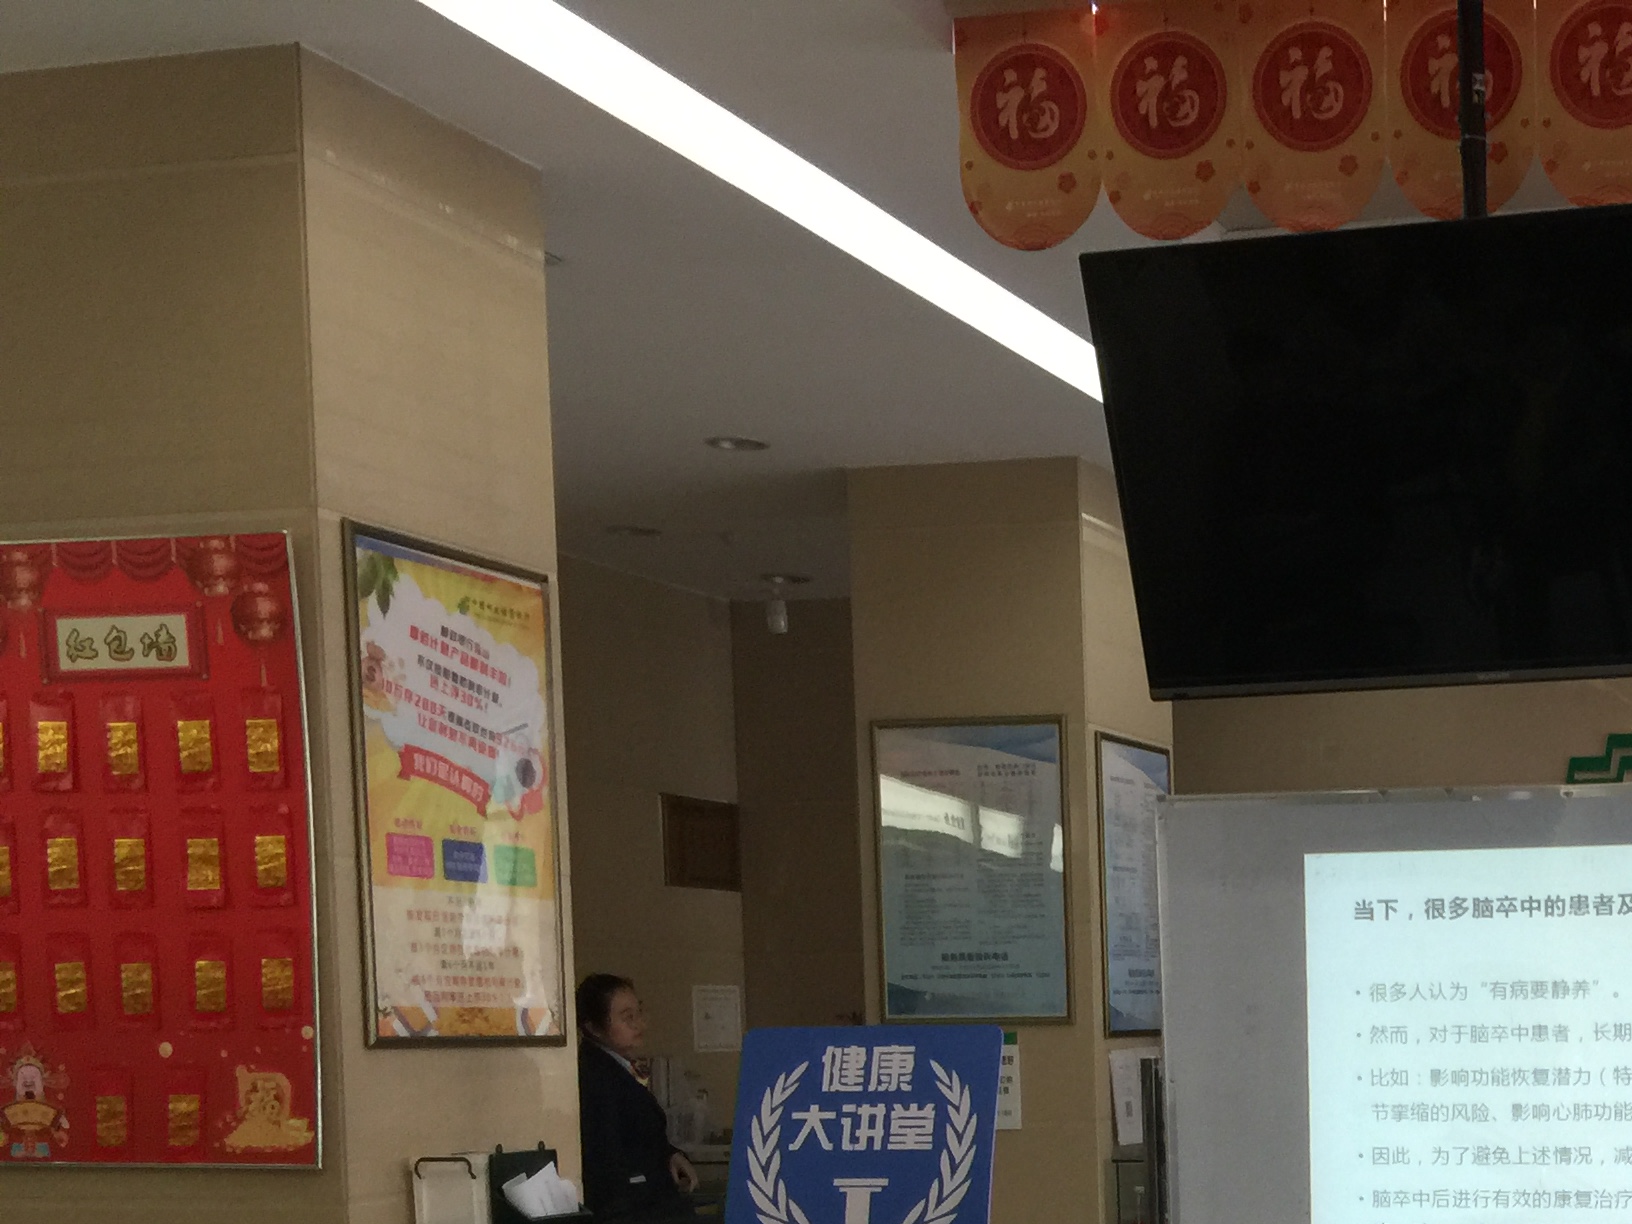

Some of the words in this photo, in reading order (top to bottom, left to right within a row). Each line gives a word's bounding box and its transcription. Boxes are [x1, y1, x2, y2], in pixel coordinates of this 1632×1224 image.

[997, 69, 1060, 140] 福
[1136, 56, 1199, 128] 福
[1279, 46, 1343, 120] 福
[66, 623, 178, 662] 红包墙
[821, 1044, 916, 1092] 健康
[788, 1103, 936, 1151] 大讲堂
